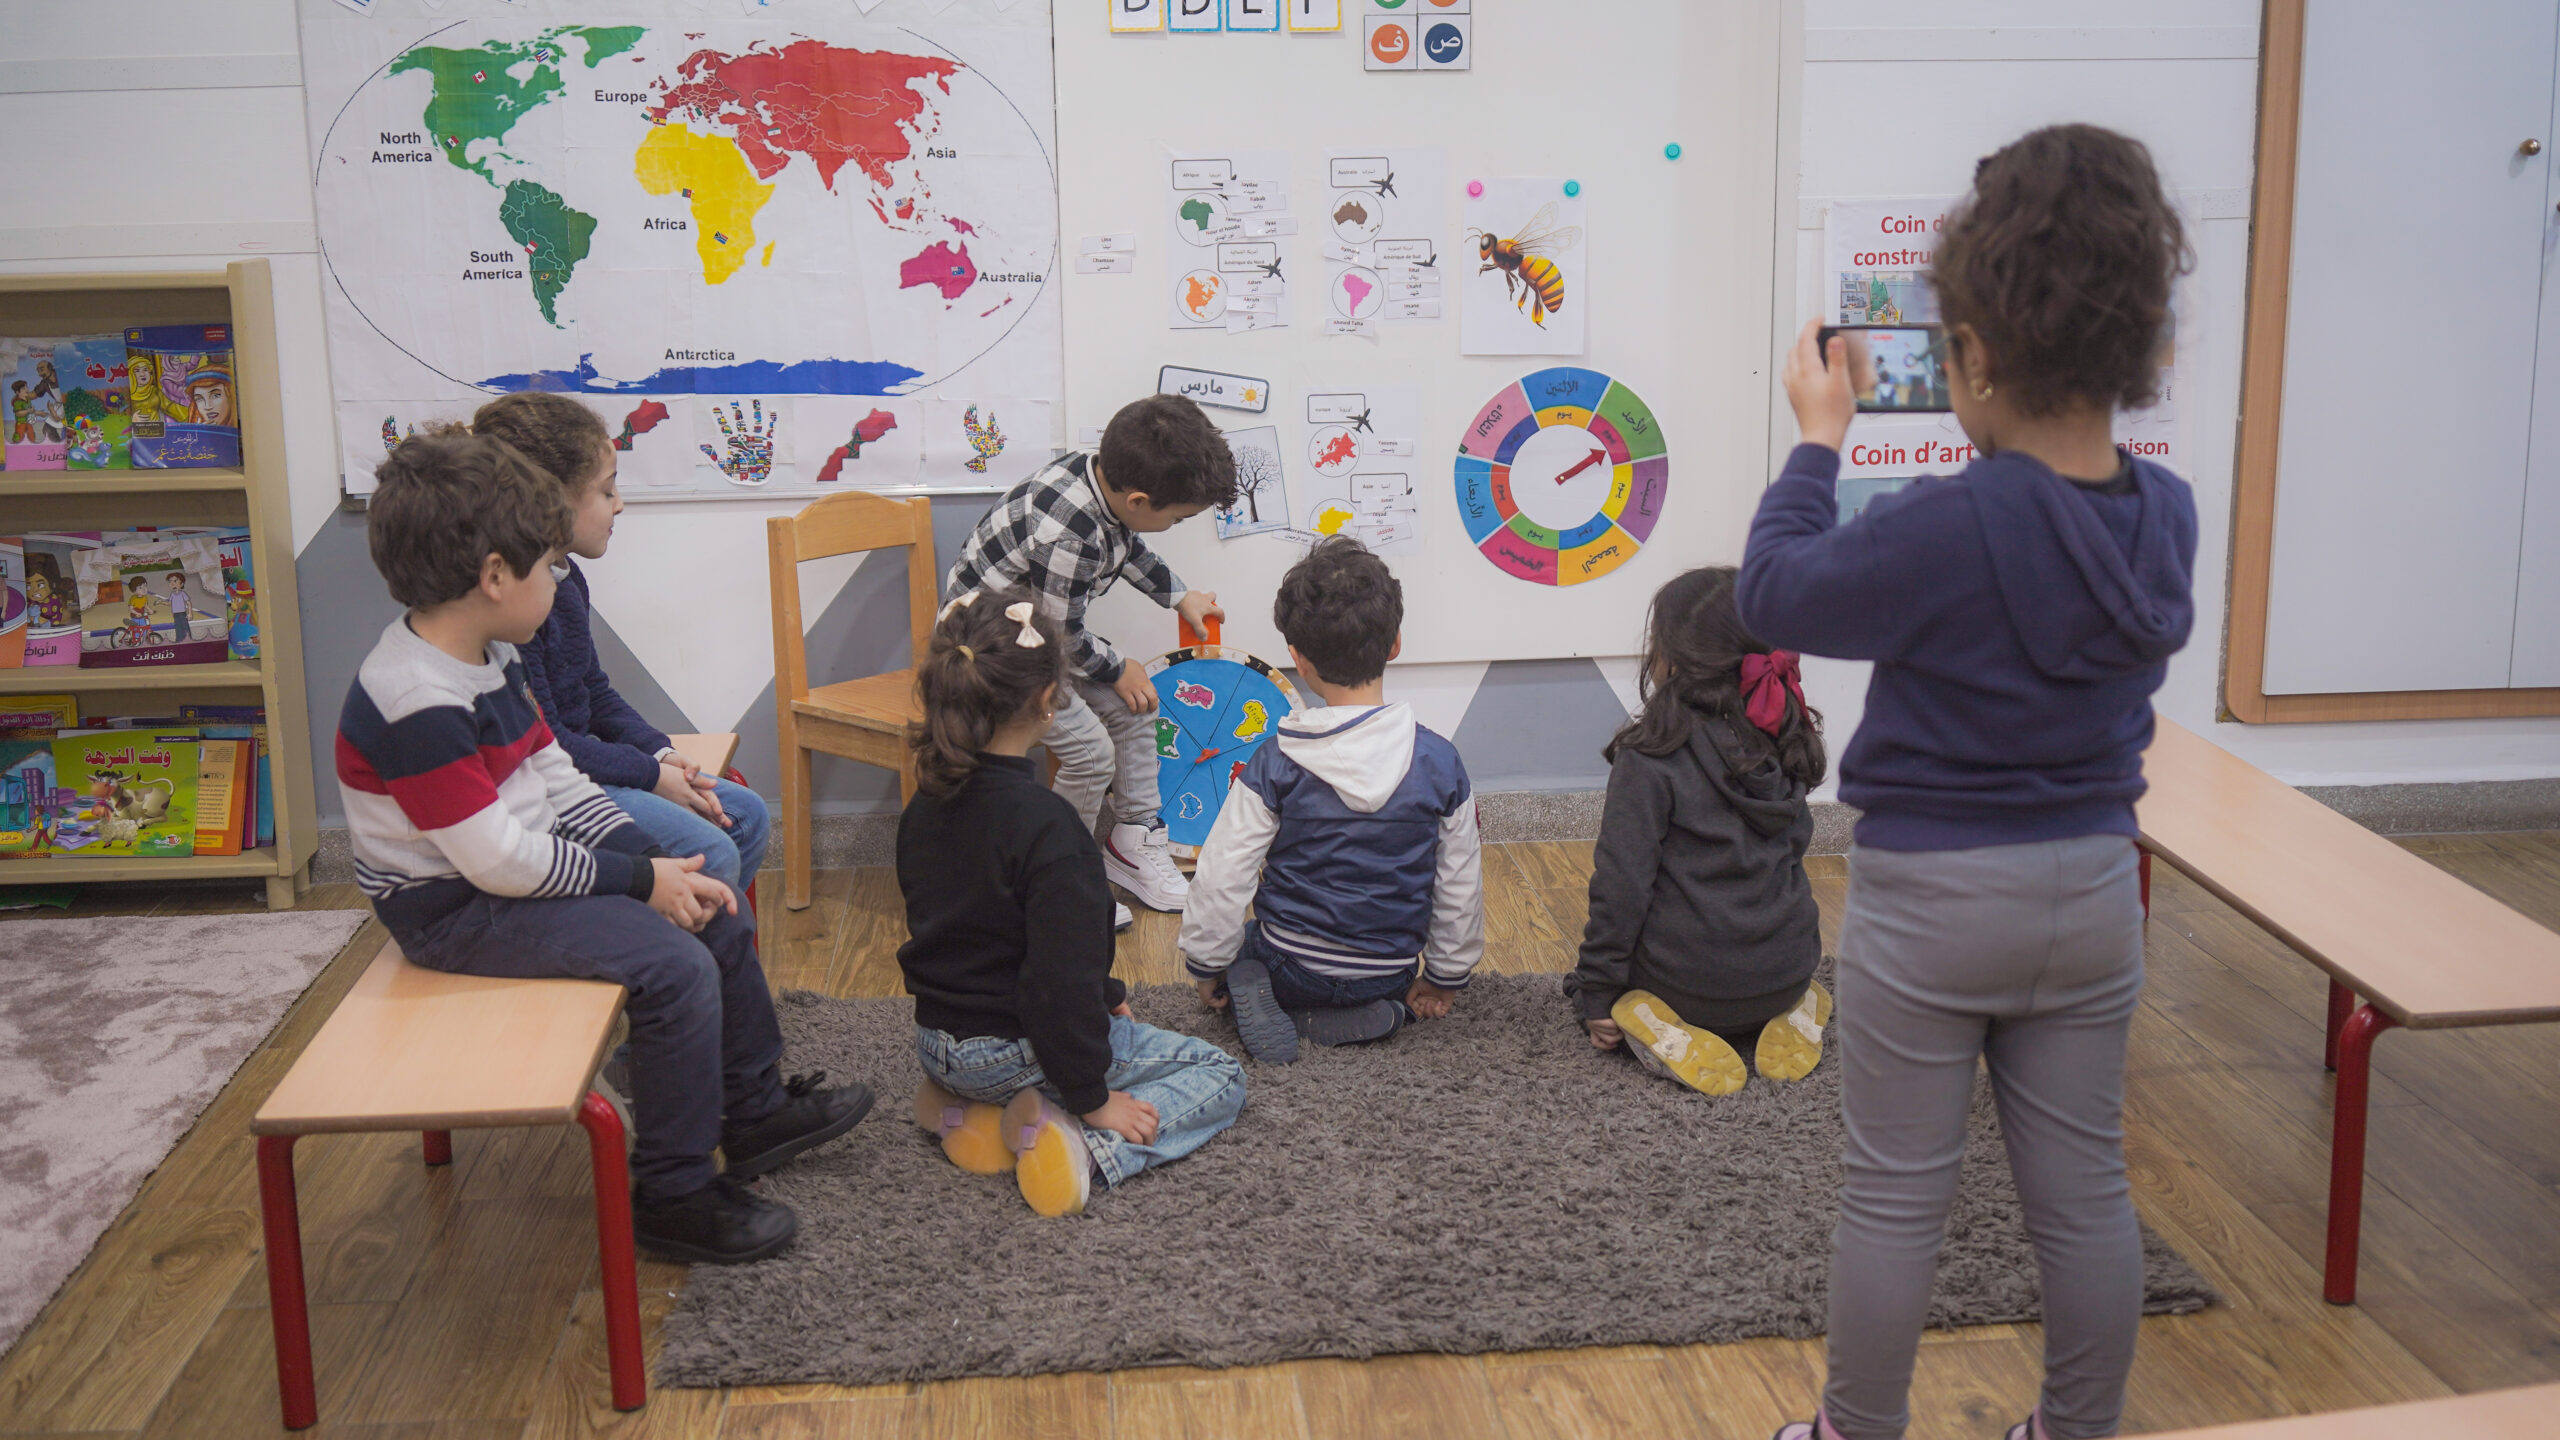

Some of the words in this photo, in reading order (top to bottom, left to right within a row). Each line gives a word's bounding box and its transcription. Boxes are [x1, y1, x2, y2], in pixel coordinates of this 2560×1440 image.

[1378, 29, 1404, 52] ف
[1430, 36, 1461, 54] ص
[594, 89, 648, 105] Europe
[380, 132, 421, 144] North
[371, 150, 432, 163] America
[927, 147, 957, 159] Asia
[644, 218, 687, 230] Africa
[1881, 215, 1926, 234] Coin
[470, 251, 514, 263] South
[1854, 248, 1931, 266] constru
[462, 269, 523, 281] America
[979, 272, 1042, 283] Australia
[1180, 379, 1224, 396] مارس
[1622, 410, 1648, 435] الأحد
[1851, 443, 1906, 466] Coin
[1914, 441, 1975, 464] d'art
[1582, 544, 1621, 574] الجمعة
[84, 746, 136, 769] النزهة
[138, 746, 172, 769] وقت
